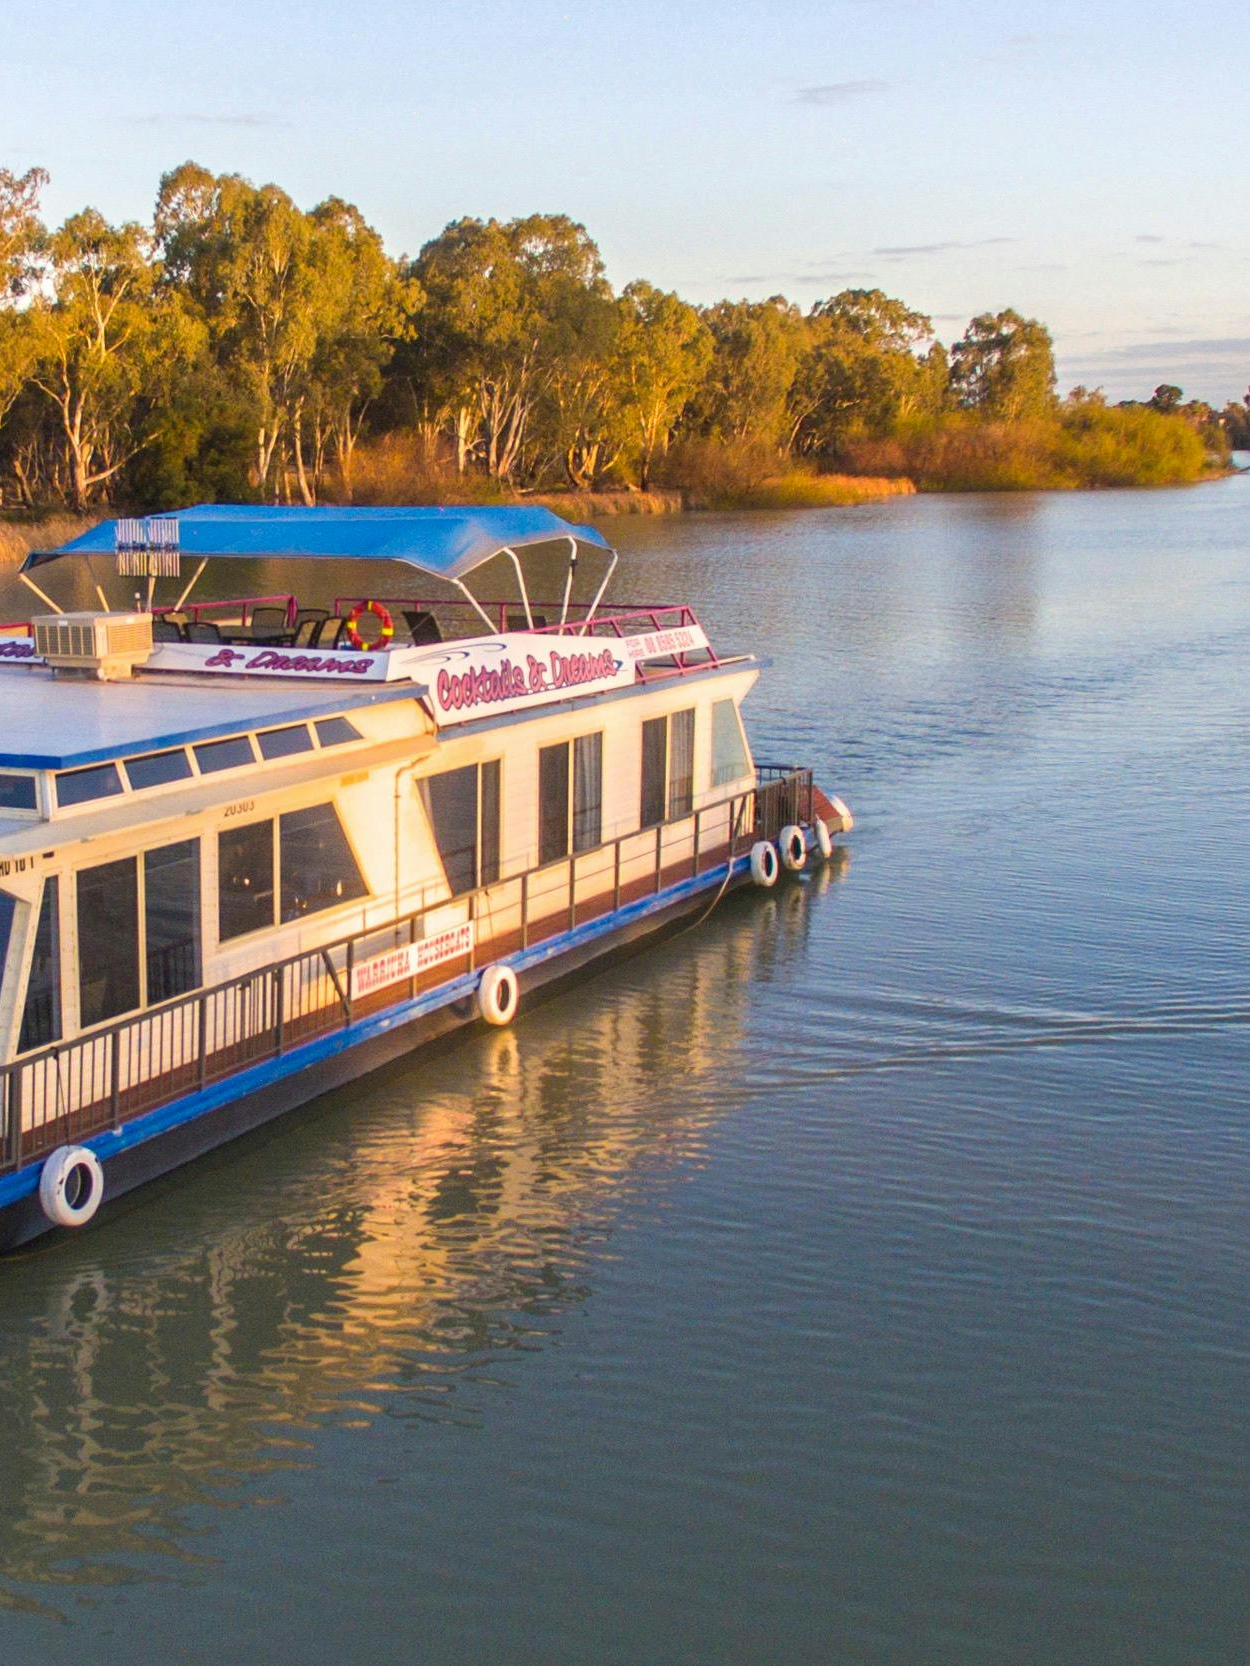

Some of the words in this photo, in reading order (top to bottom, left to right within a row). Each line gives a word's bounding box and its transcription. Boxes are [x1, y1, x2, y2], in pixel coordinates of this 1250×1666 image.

[204, 649, 245, 667] &
[245, 651, 374, 673] Dreams
[437, 658, 527, 712] Cocktails
[526, 654, 548, 692] &
[550, 649, 617, 687] Dreams
[416, 925, 470, 968] HOUSEBOATS
